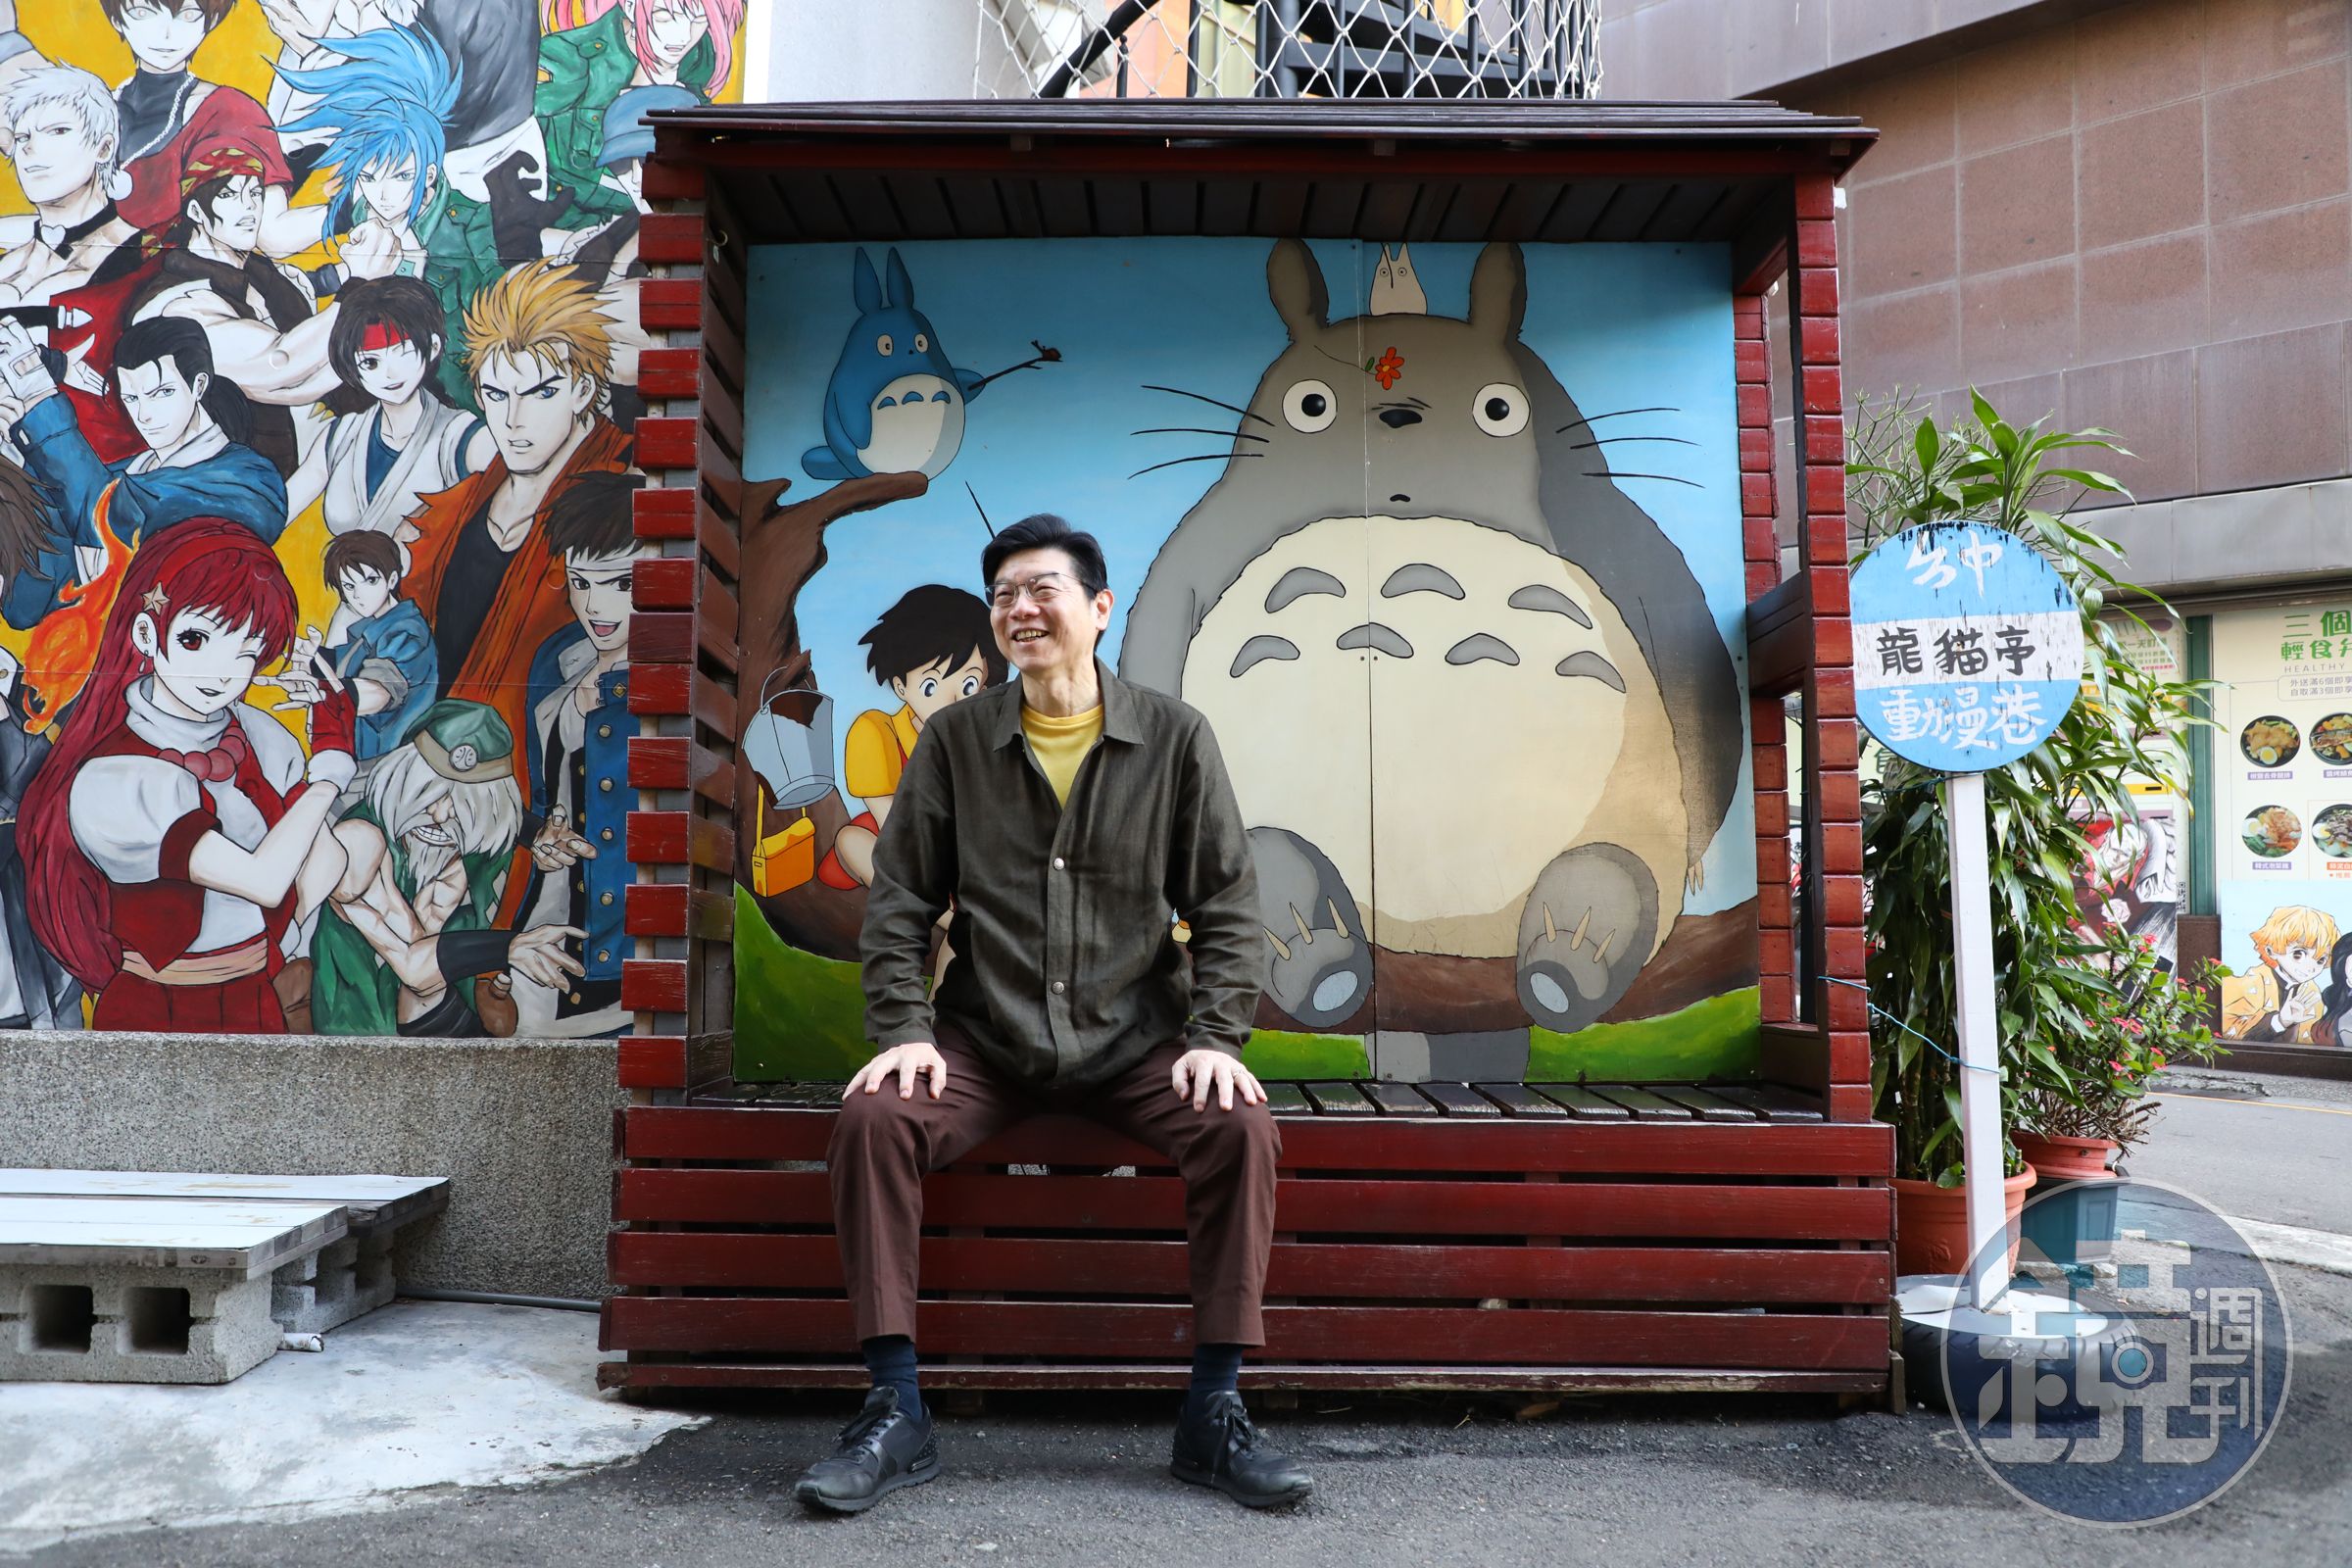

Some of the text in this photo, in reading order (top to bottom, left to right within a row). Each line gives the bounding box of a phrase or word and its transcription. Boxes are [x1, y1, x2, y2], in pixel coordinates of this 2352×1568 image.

[2281, 610, 2352, 638] 三個
[1877, 624, 2035, 676] 龍貓亭
[2284, 662, 2345, 674] HEALTHY
[1879, 684, 2047, 750] 動漫巷
